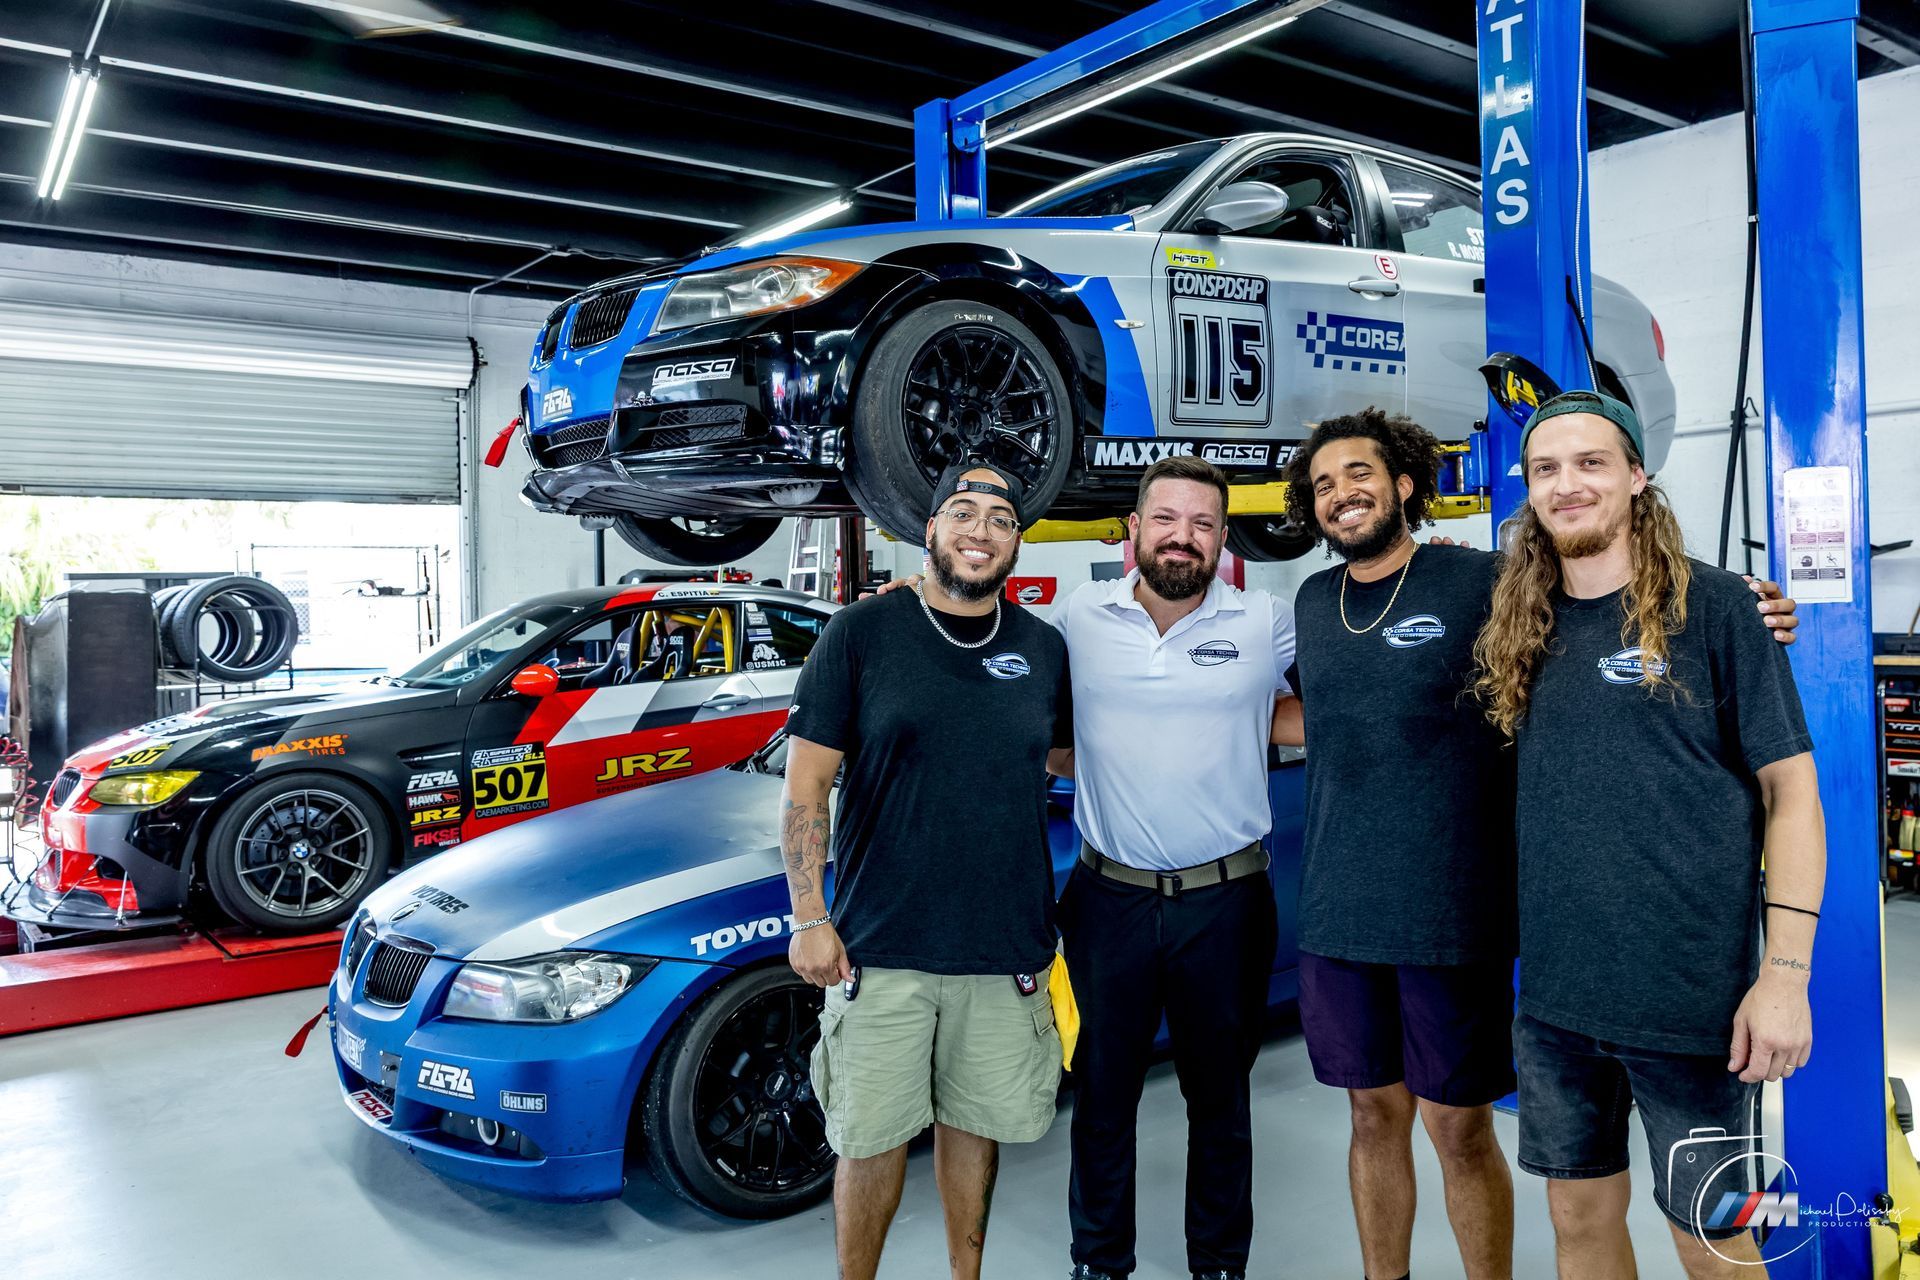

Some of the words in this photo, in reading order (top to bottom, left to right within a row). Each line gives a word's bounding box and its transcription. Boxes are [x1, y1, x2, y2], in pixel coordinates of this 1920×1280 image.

[1380, 258, 1393, 273] E
[1174, 272, 1264, 301] CONSPDSHP
[1179, 313, 1265, 406] 115
[671, 590, 710, 598] ESPITIA
[251, 734, 344, 762] MAXXIS
[309, 747, 345, 756] TIRES
[524, 751, 545, 761] SL1
[596, 747, 692, 782] JRZ
[475, 762, 546, 806] 507
[409, 793, 443, 806] HAWK
[476, 800, 549, 817] CAEMARKETING.COM
[410, 805, 461, 825] JRZ
[414, 828, 460, 848] FIKSE
[503, 1092, 544, 1111] ÖHLINS
